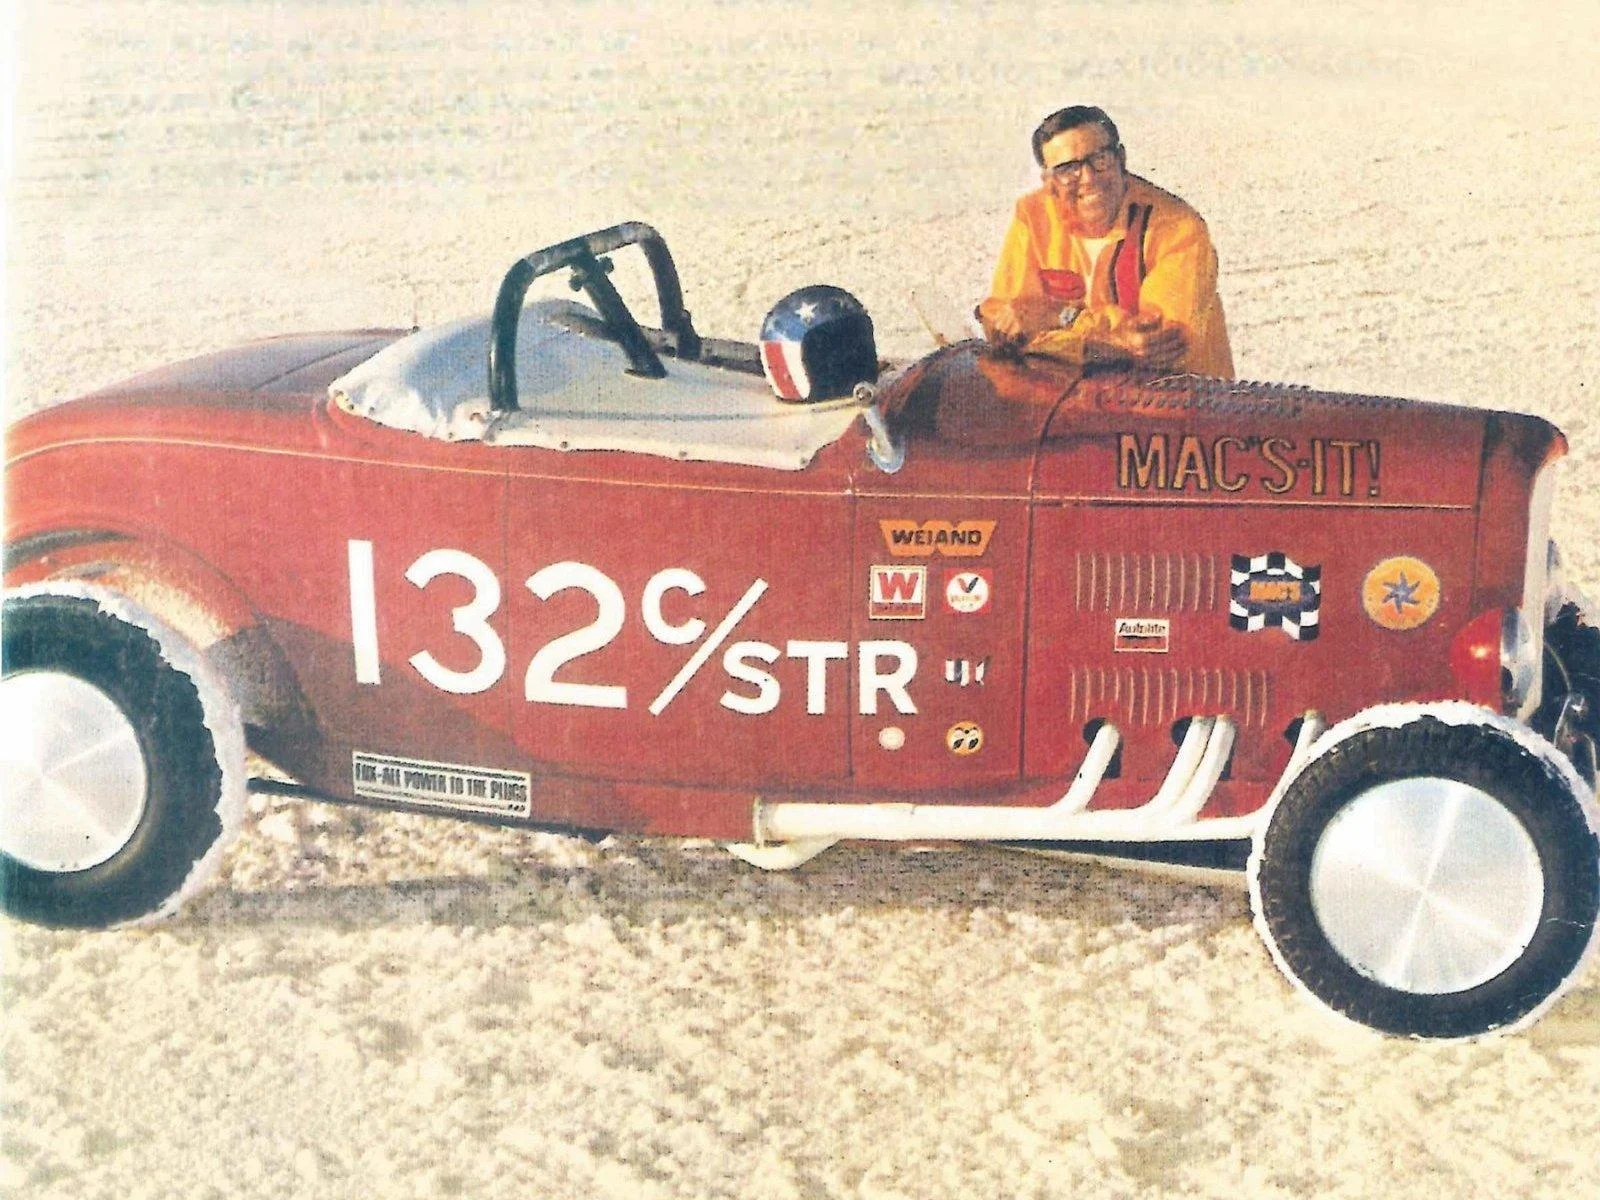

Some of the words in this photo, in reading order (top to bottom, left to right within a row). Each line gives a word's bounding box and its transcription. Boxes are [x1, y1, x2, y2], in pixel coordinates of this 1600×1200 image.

[891, 529, 983, 546] WEIAND
[347, 539, 628, 709] 132
[404, 770, 447, 794] POWER
[450, 775, 464, 795] TO
[490, 780, 527, 802] PLUGS
